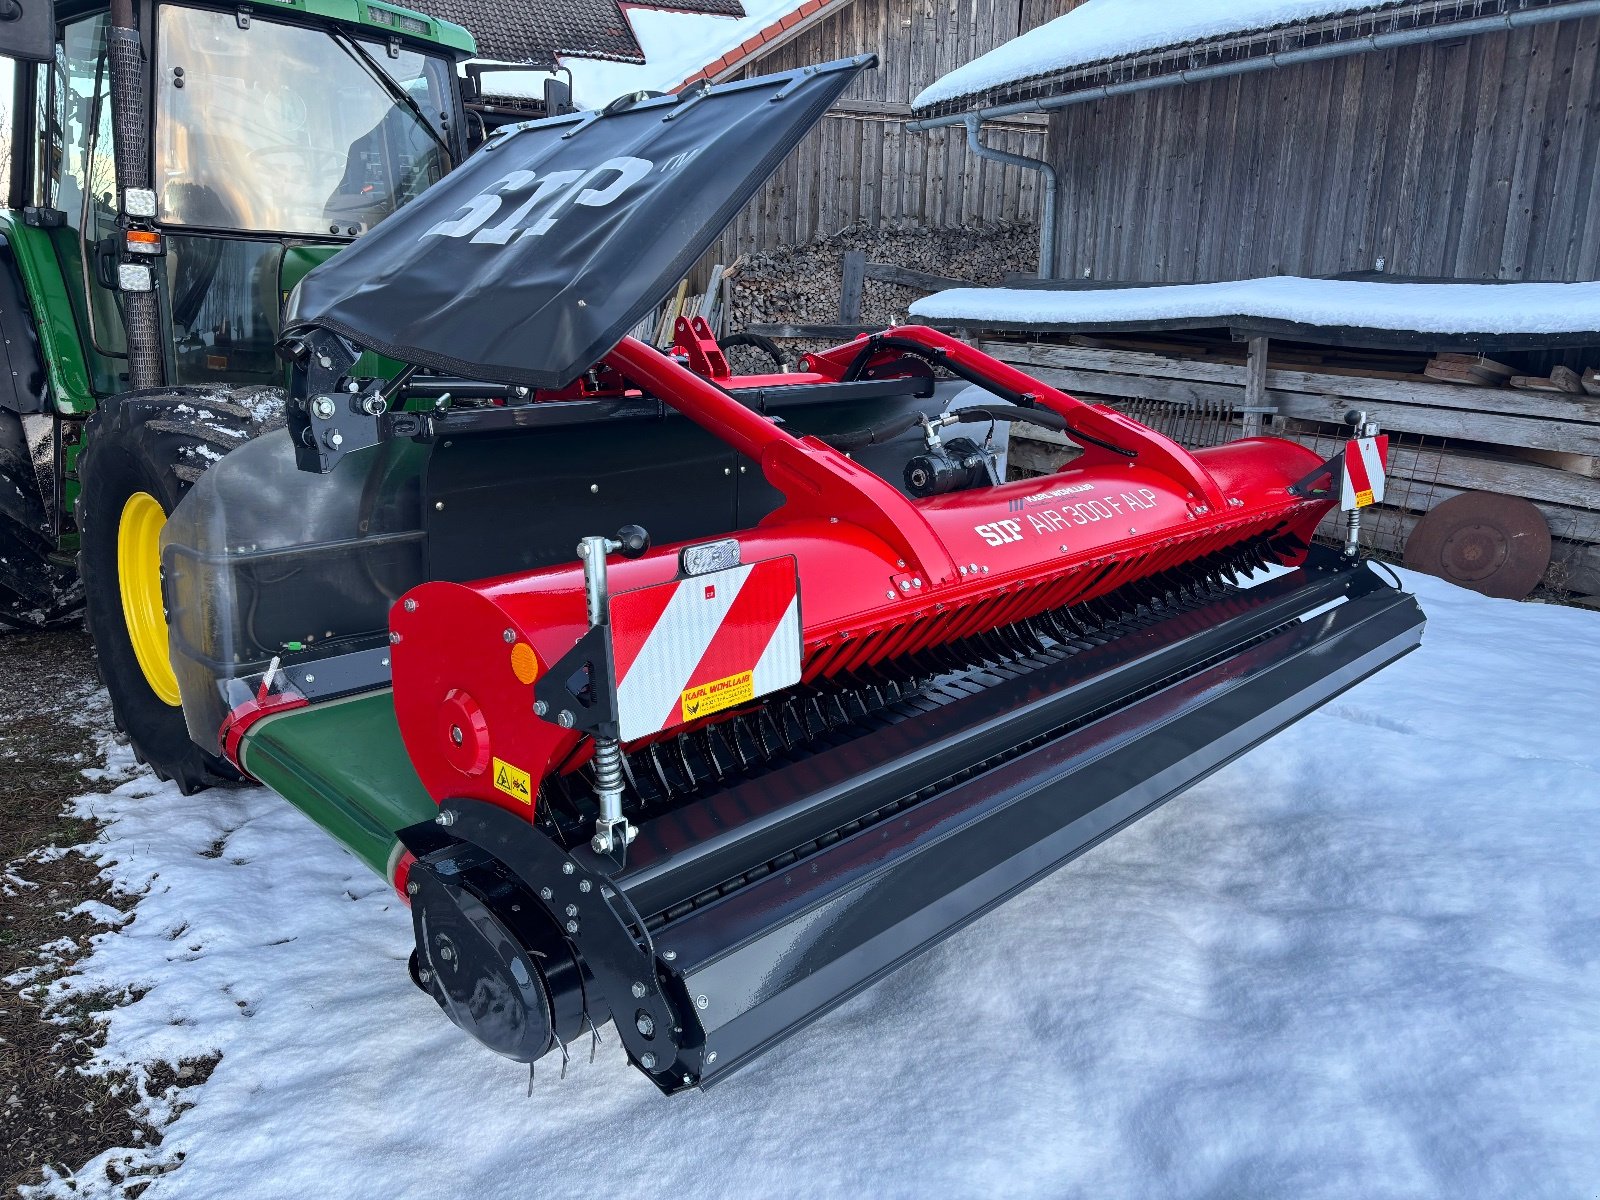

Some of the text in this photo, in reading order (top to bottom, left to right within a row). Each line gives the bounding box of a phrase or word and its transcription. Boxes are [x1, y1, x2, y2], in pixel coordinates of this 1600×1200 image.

[418, 156, 654, 245] SIP
[974, 519, 1024, 547] SIP
[1026, 509, 1072, 535] AIR
[1061, 499, 1113, 525] 300
[1106, 496, 1125, 515] F
[1119, 488, 1158, 512] ALP
[684, 688, 708, 702] KARL
